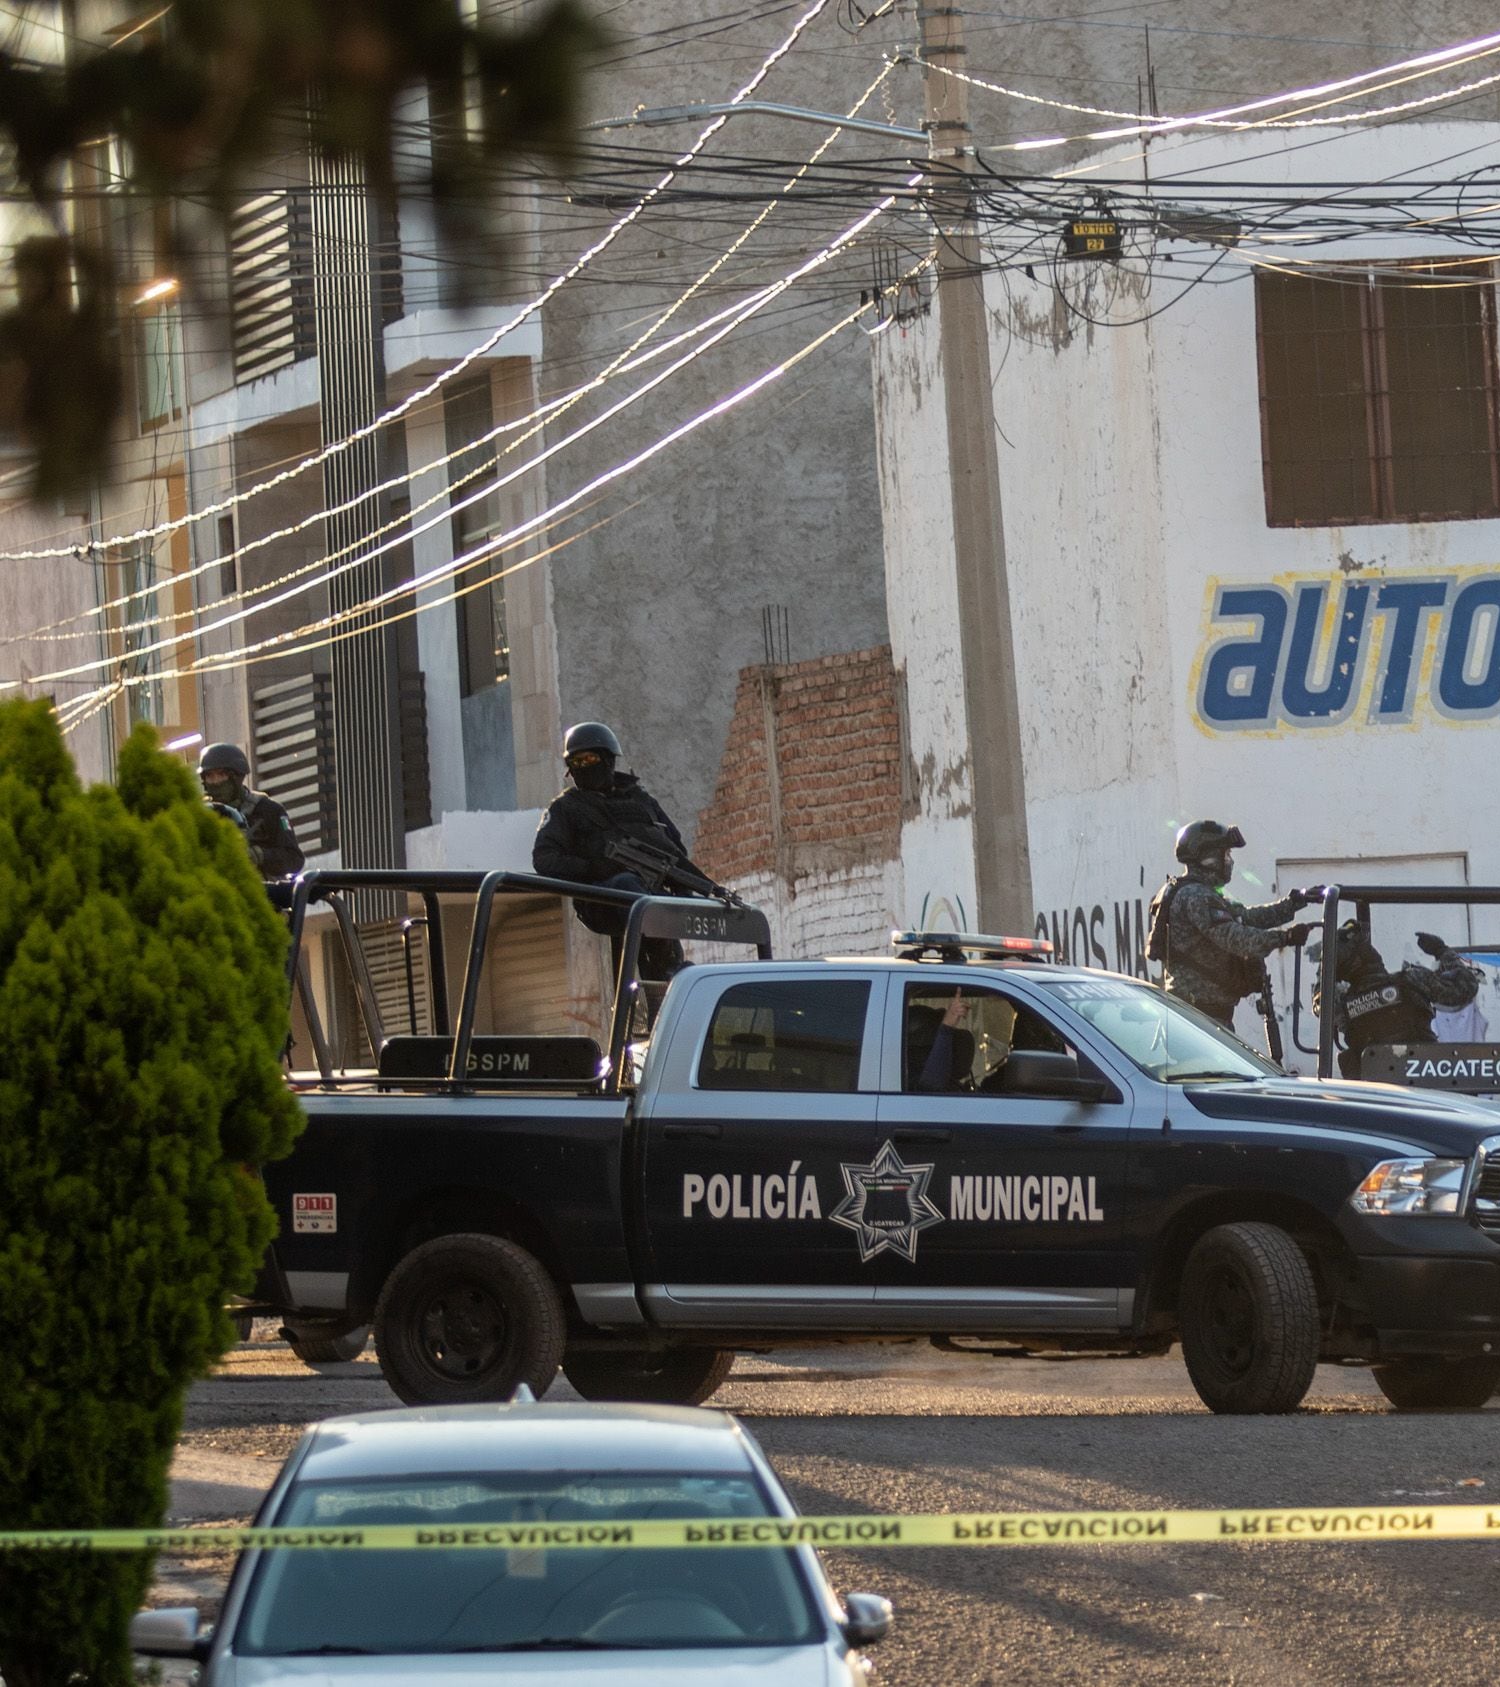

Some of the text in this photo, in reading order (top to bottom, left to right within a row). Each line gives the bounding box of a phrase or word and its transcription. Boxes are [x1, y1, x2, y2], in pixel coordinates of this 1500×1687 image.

[1035, 905, 1108, 970] OMOS
[298, 1198, 330, 1209] 911
[683, 1160, 1104, 1221] POLICÍA MUNICIPAL
